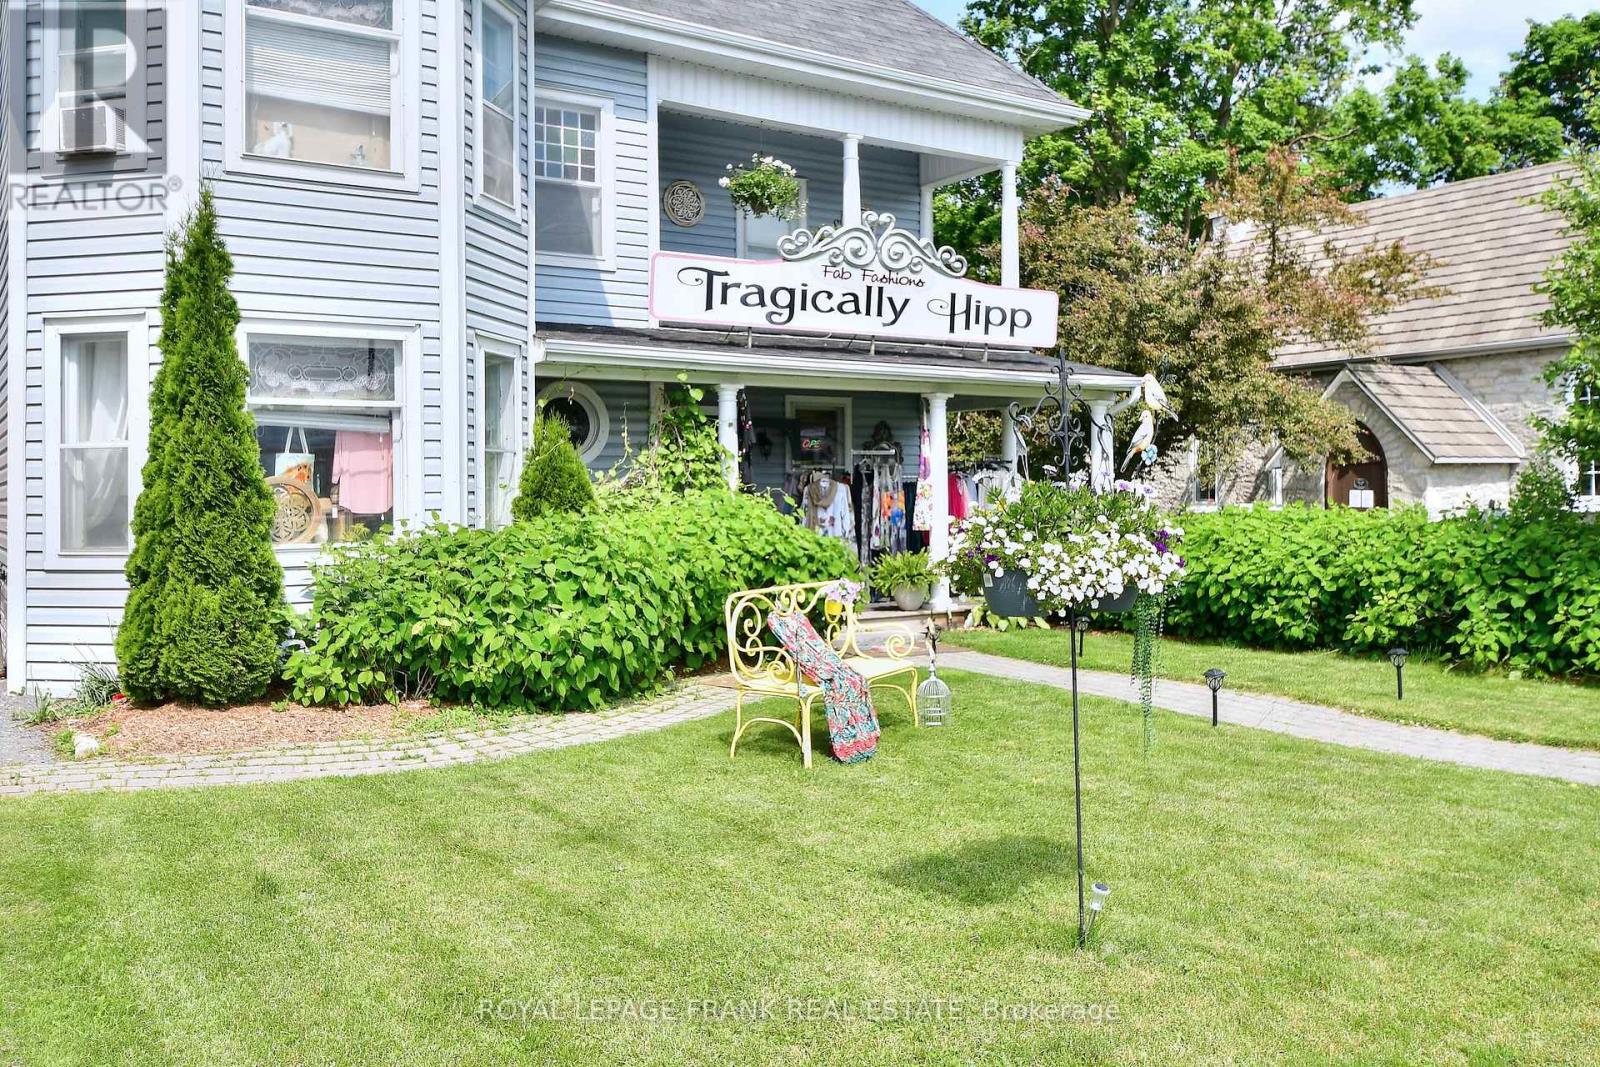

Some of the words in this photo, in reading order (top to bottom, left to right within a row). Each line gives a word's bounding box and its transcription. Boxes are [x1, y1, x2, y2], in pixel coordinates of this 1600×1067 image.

[821, 264, 852, 280] Fab
[861, 268, 926, 288] Fashions
[677, 266, 911, 326] Tragically
[927, 292, 1033, 337] Hipp
